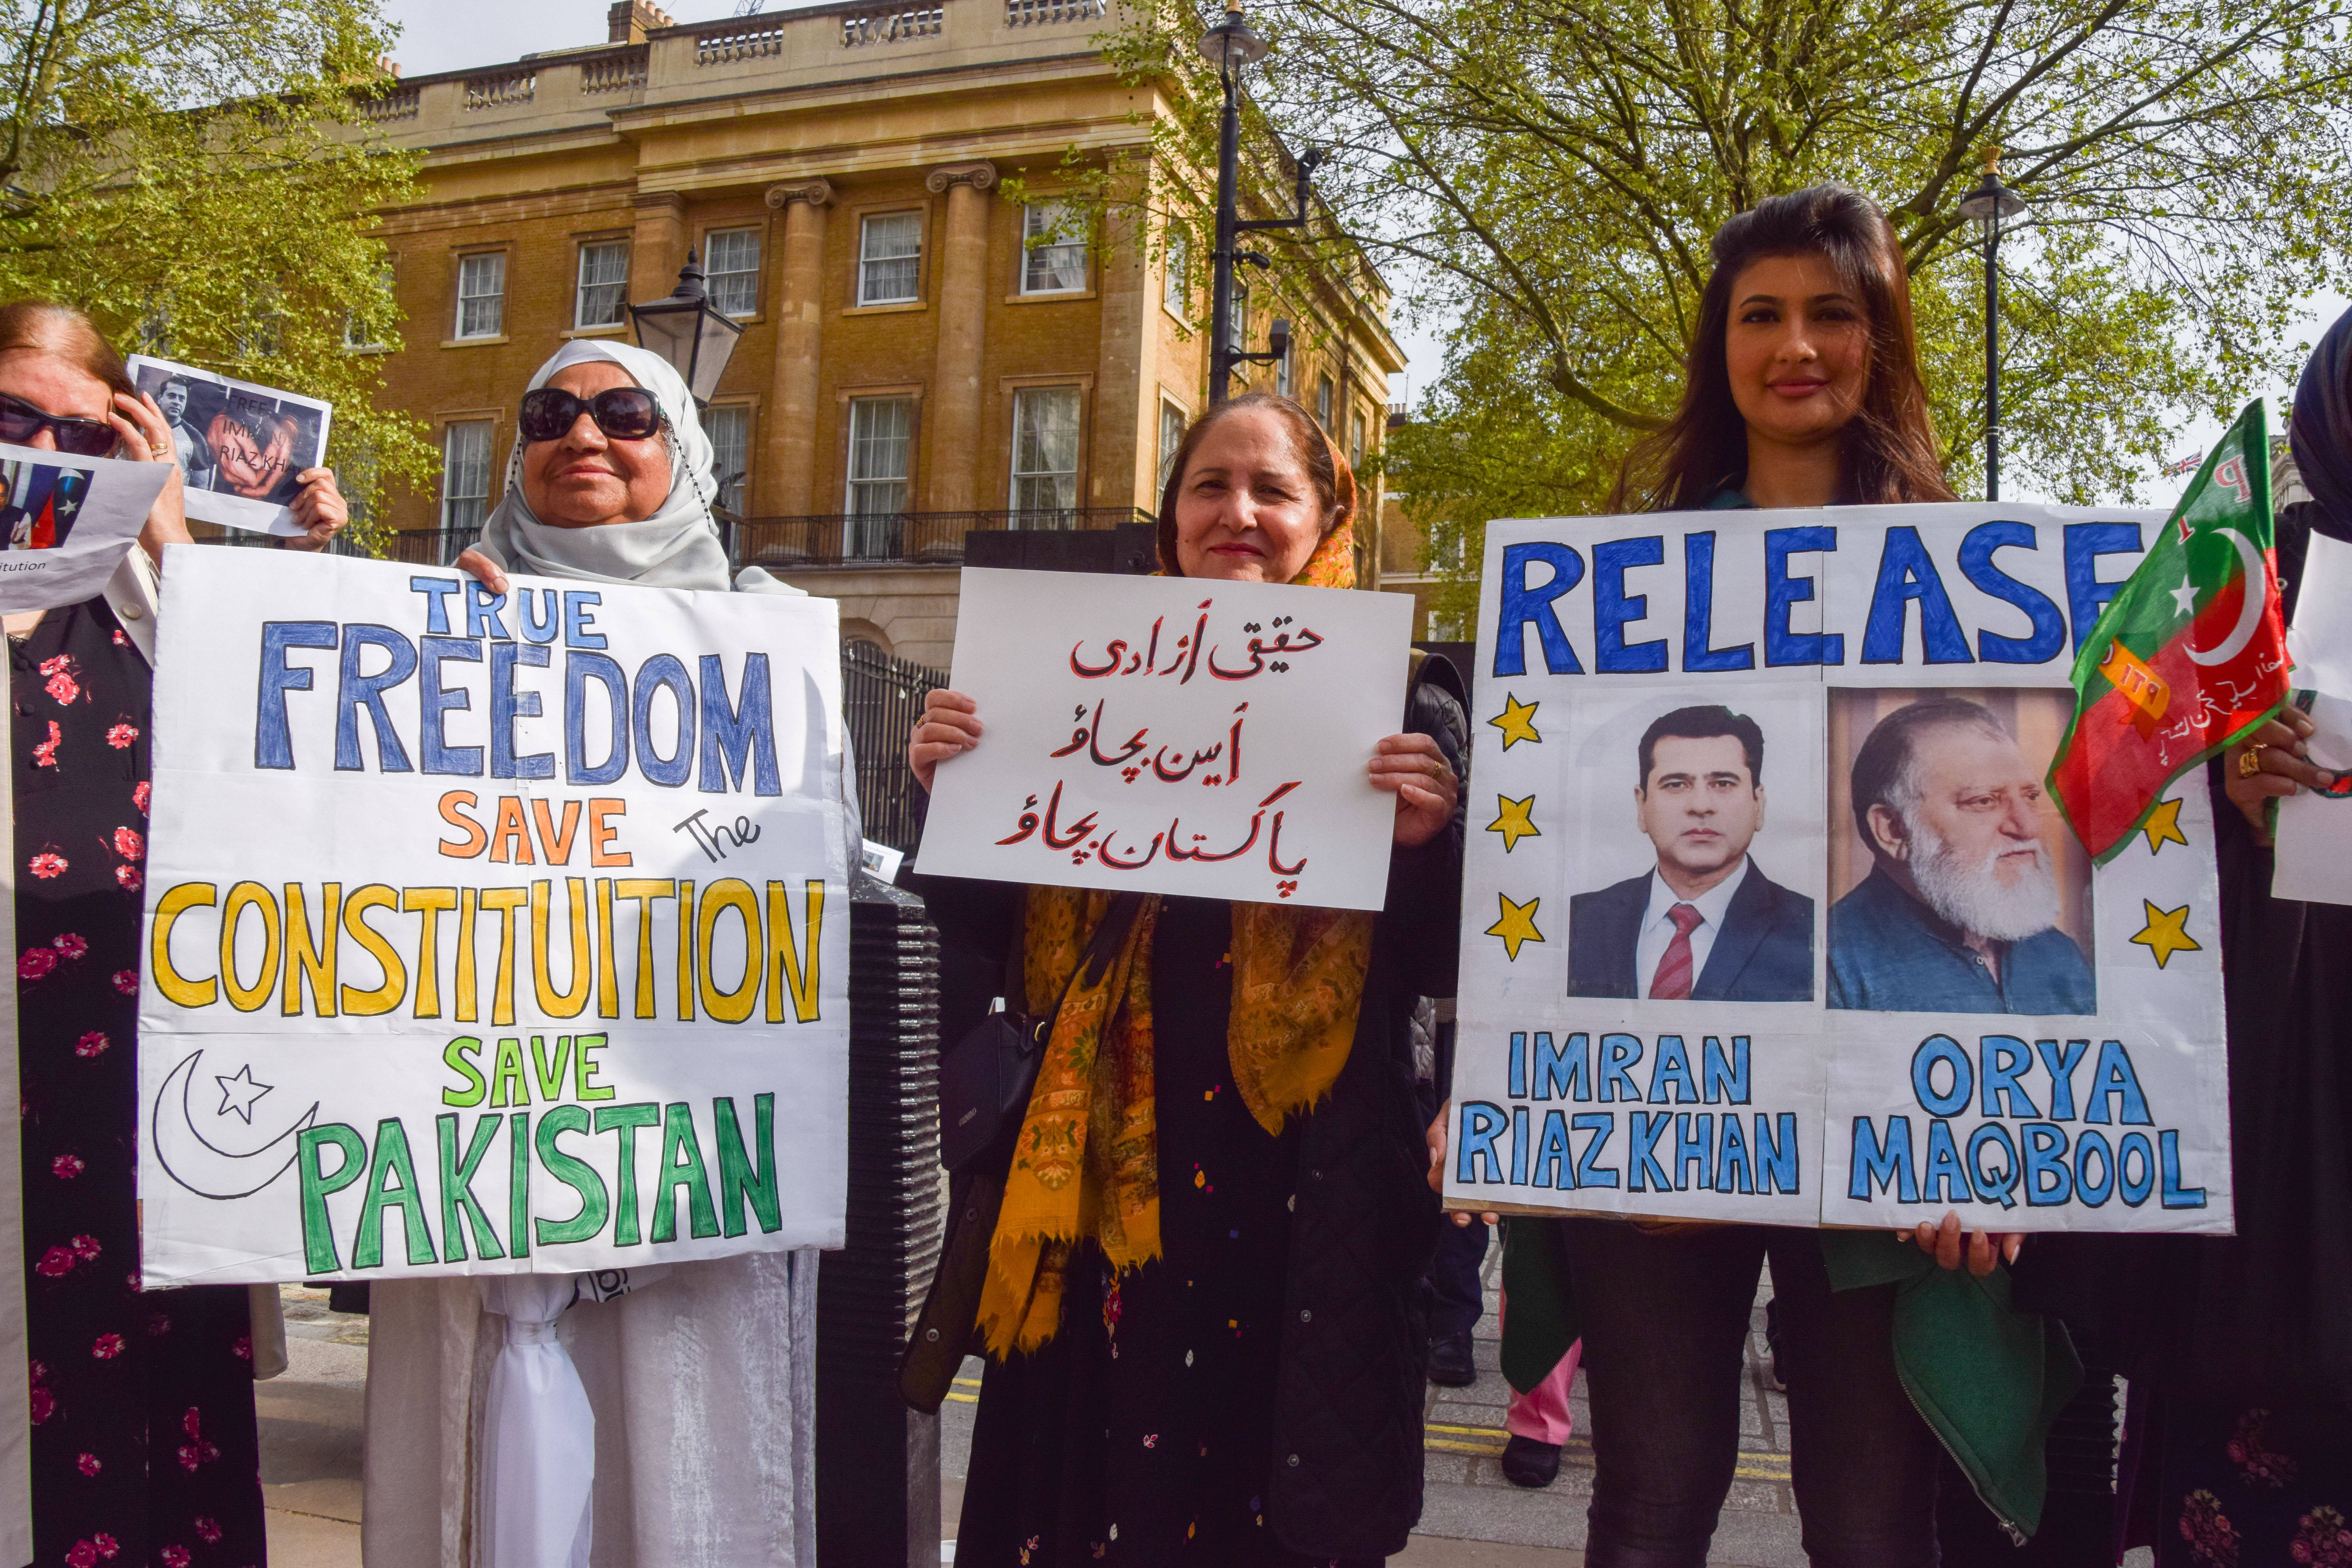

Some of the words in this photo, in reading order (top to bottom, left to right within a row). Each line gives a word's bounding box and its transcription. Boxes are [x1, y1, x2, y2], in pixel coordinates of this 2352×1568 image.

[228, 395, 268, 414] FREE
[220, 445, 258, 466] RIAZ
[410, 575, 608, 650] TRUE
[254, 620, 783, 797] FREEDOM
[439, 789, 634, 868] SAVE
[673, 808, 761, 864] The
[151, 877, 826, 1027] CONSTITUITION
[442, 1032, 616, 1108] SAVE
[1507, 1031, 1752, 1105] IMRAN
[1910, 1033, 2155, 1127] ORYA
[297, 1092, 783, 1276] PAKISTAN
[1456, 1100, 1620, 1191] RIAZ
[1626, 1111, 1801, 1196] KHAN
[1847, 1114, 2208, 1211] MAQBOOL
